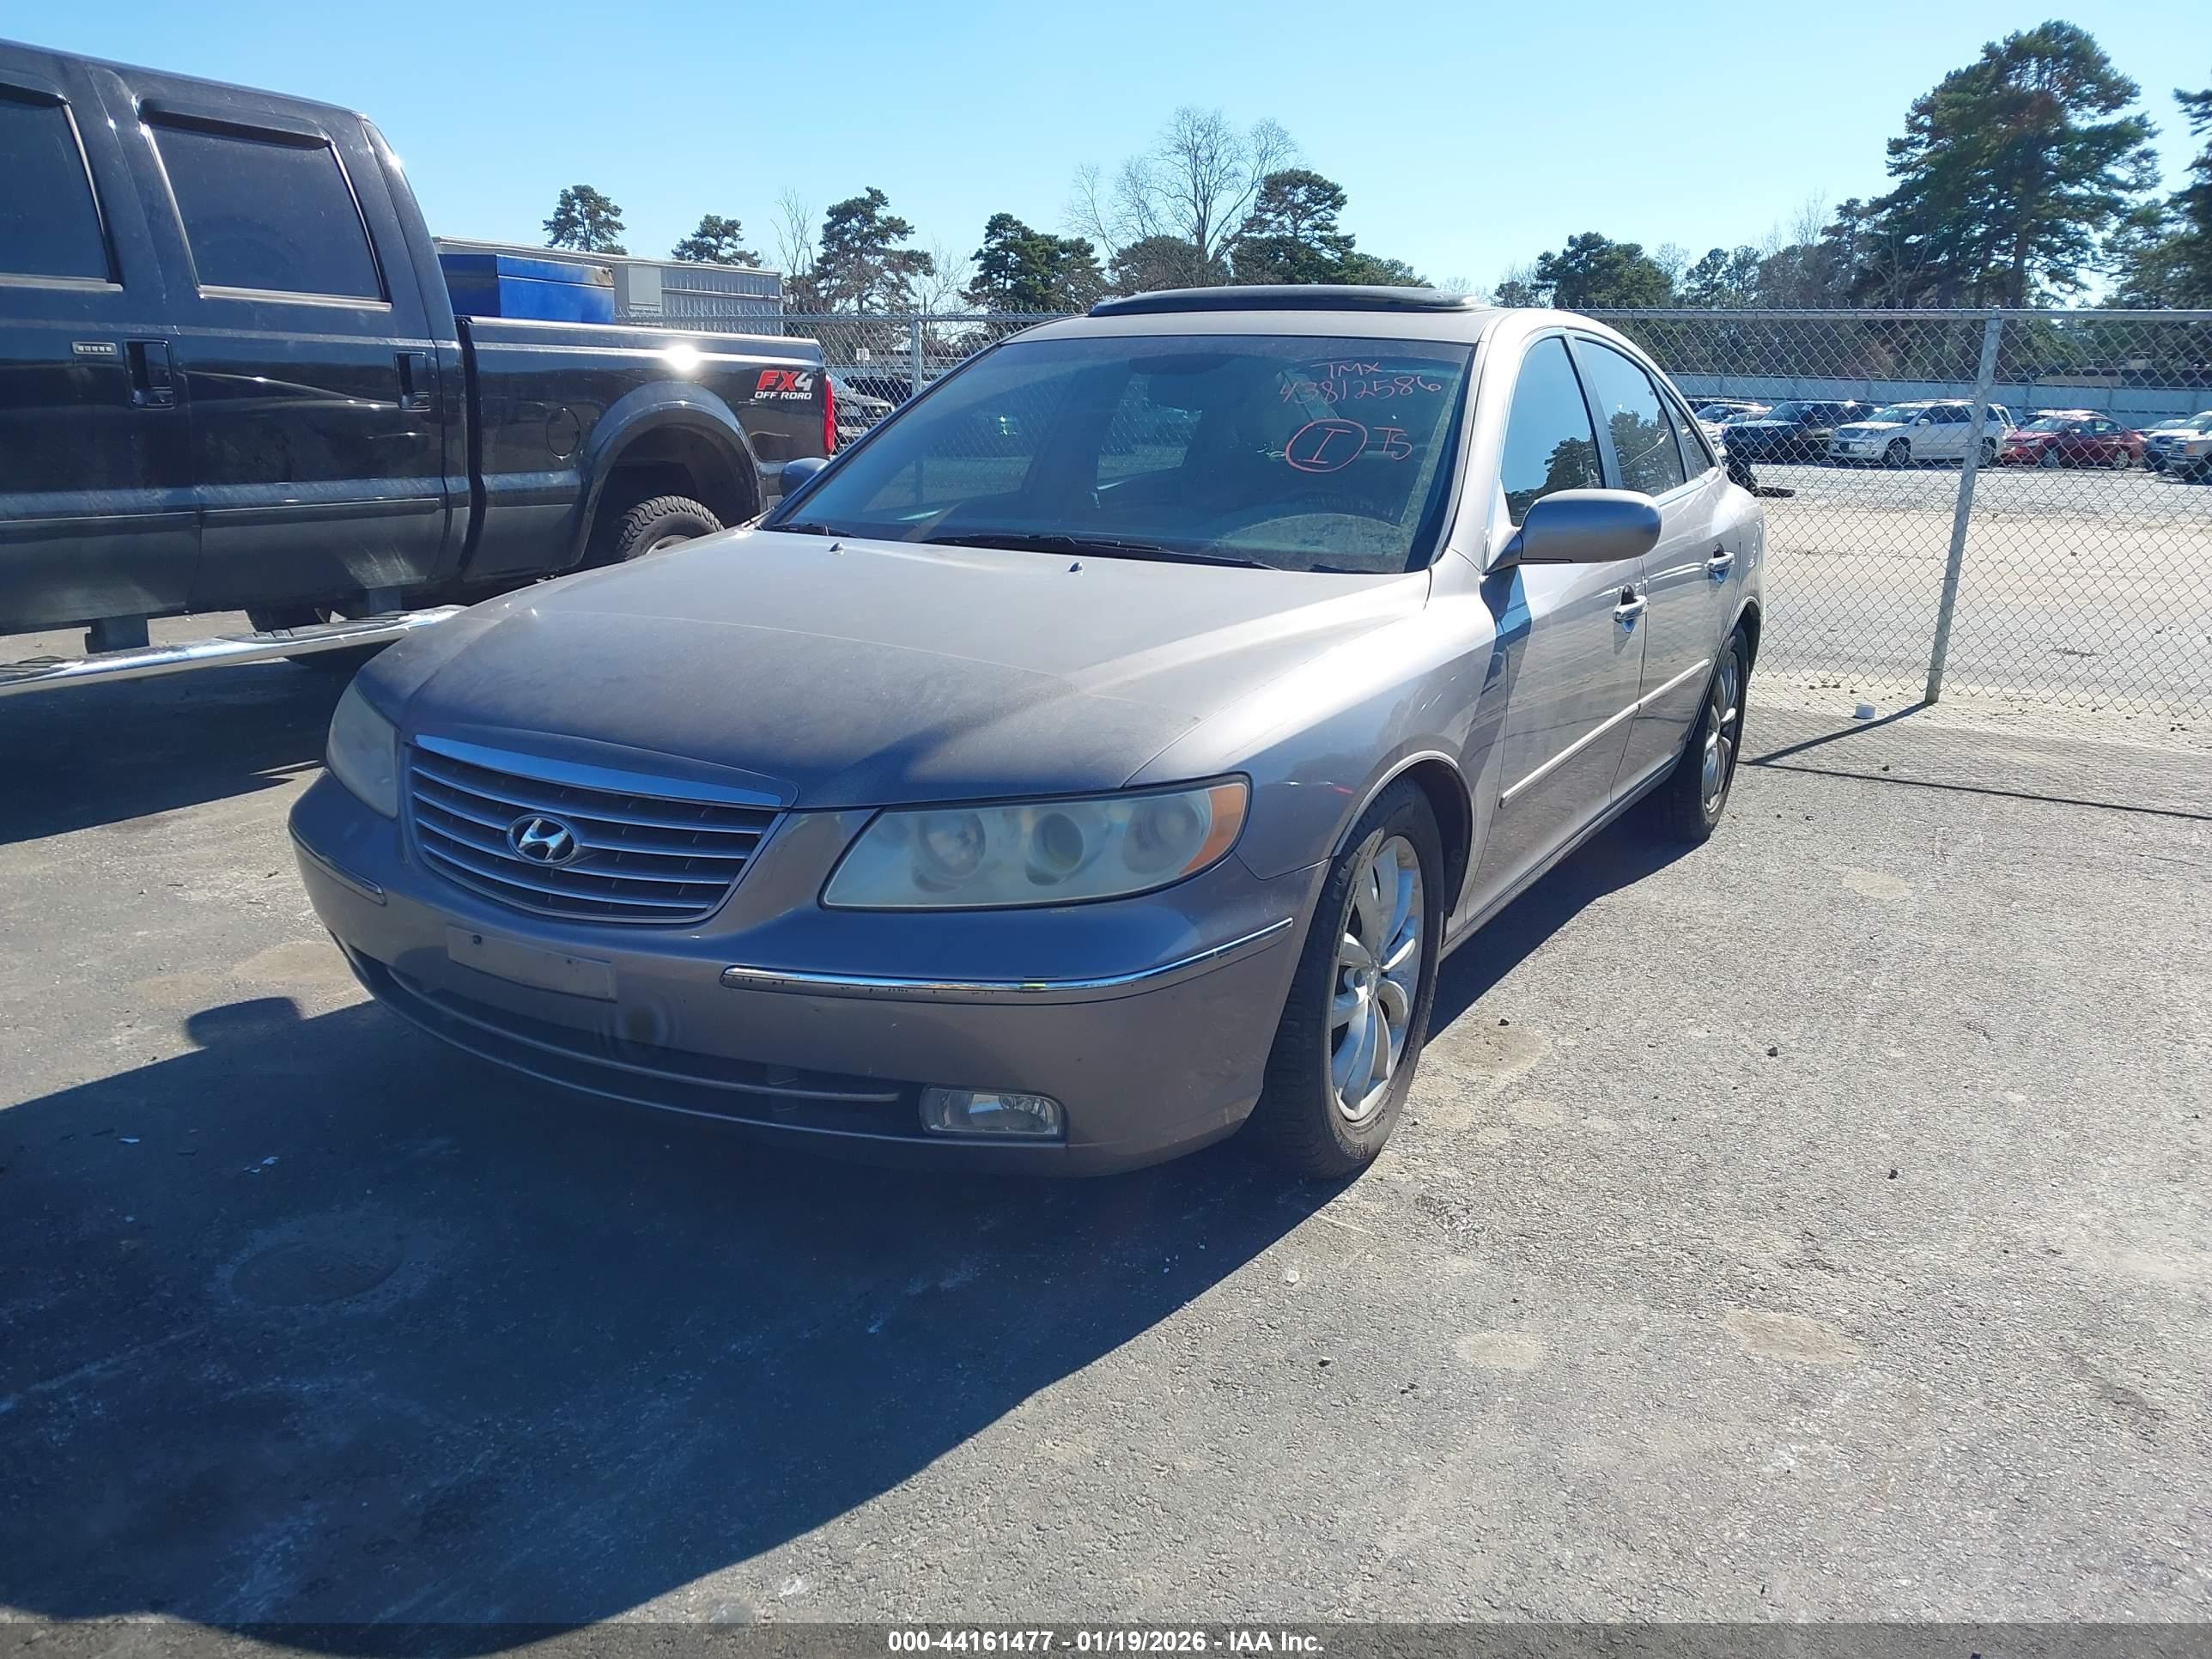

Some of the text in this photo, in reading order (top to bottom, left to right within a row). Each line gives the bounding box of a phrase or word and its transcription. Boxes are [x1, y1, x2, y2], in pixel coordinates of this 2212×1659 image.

[757, 369, 813, 391] FX4
[1279, 375, 1443, 404] 43812586
[754, 391, 812, 400] OFF ROAD
